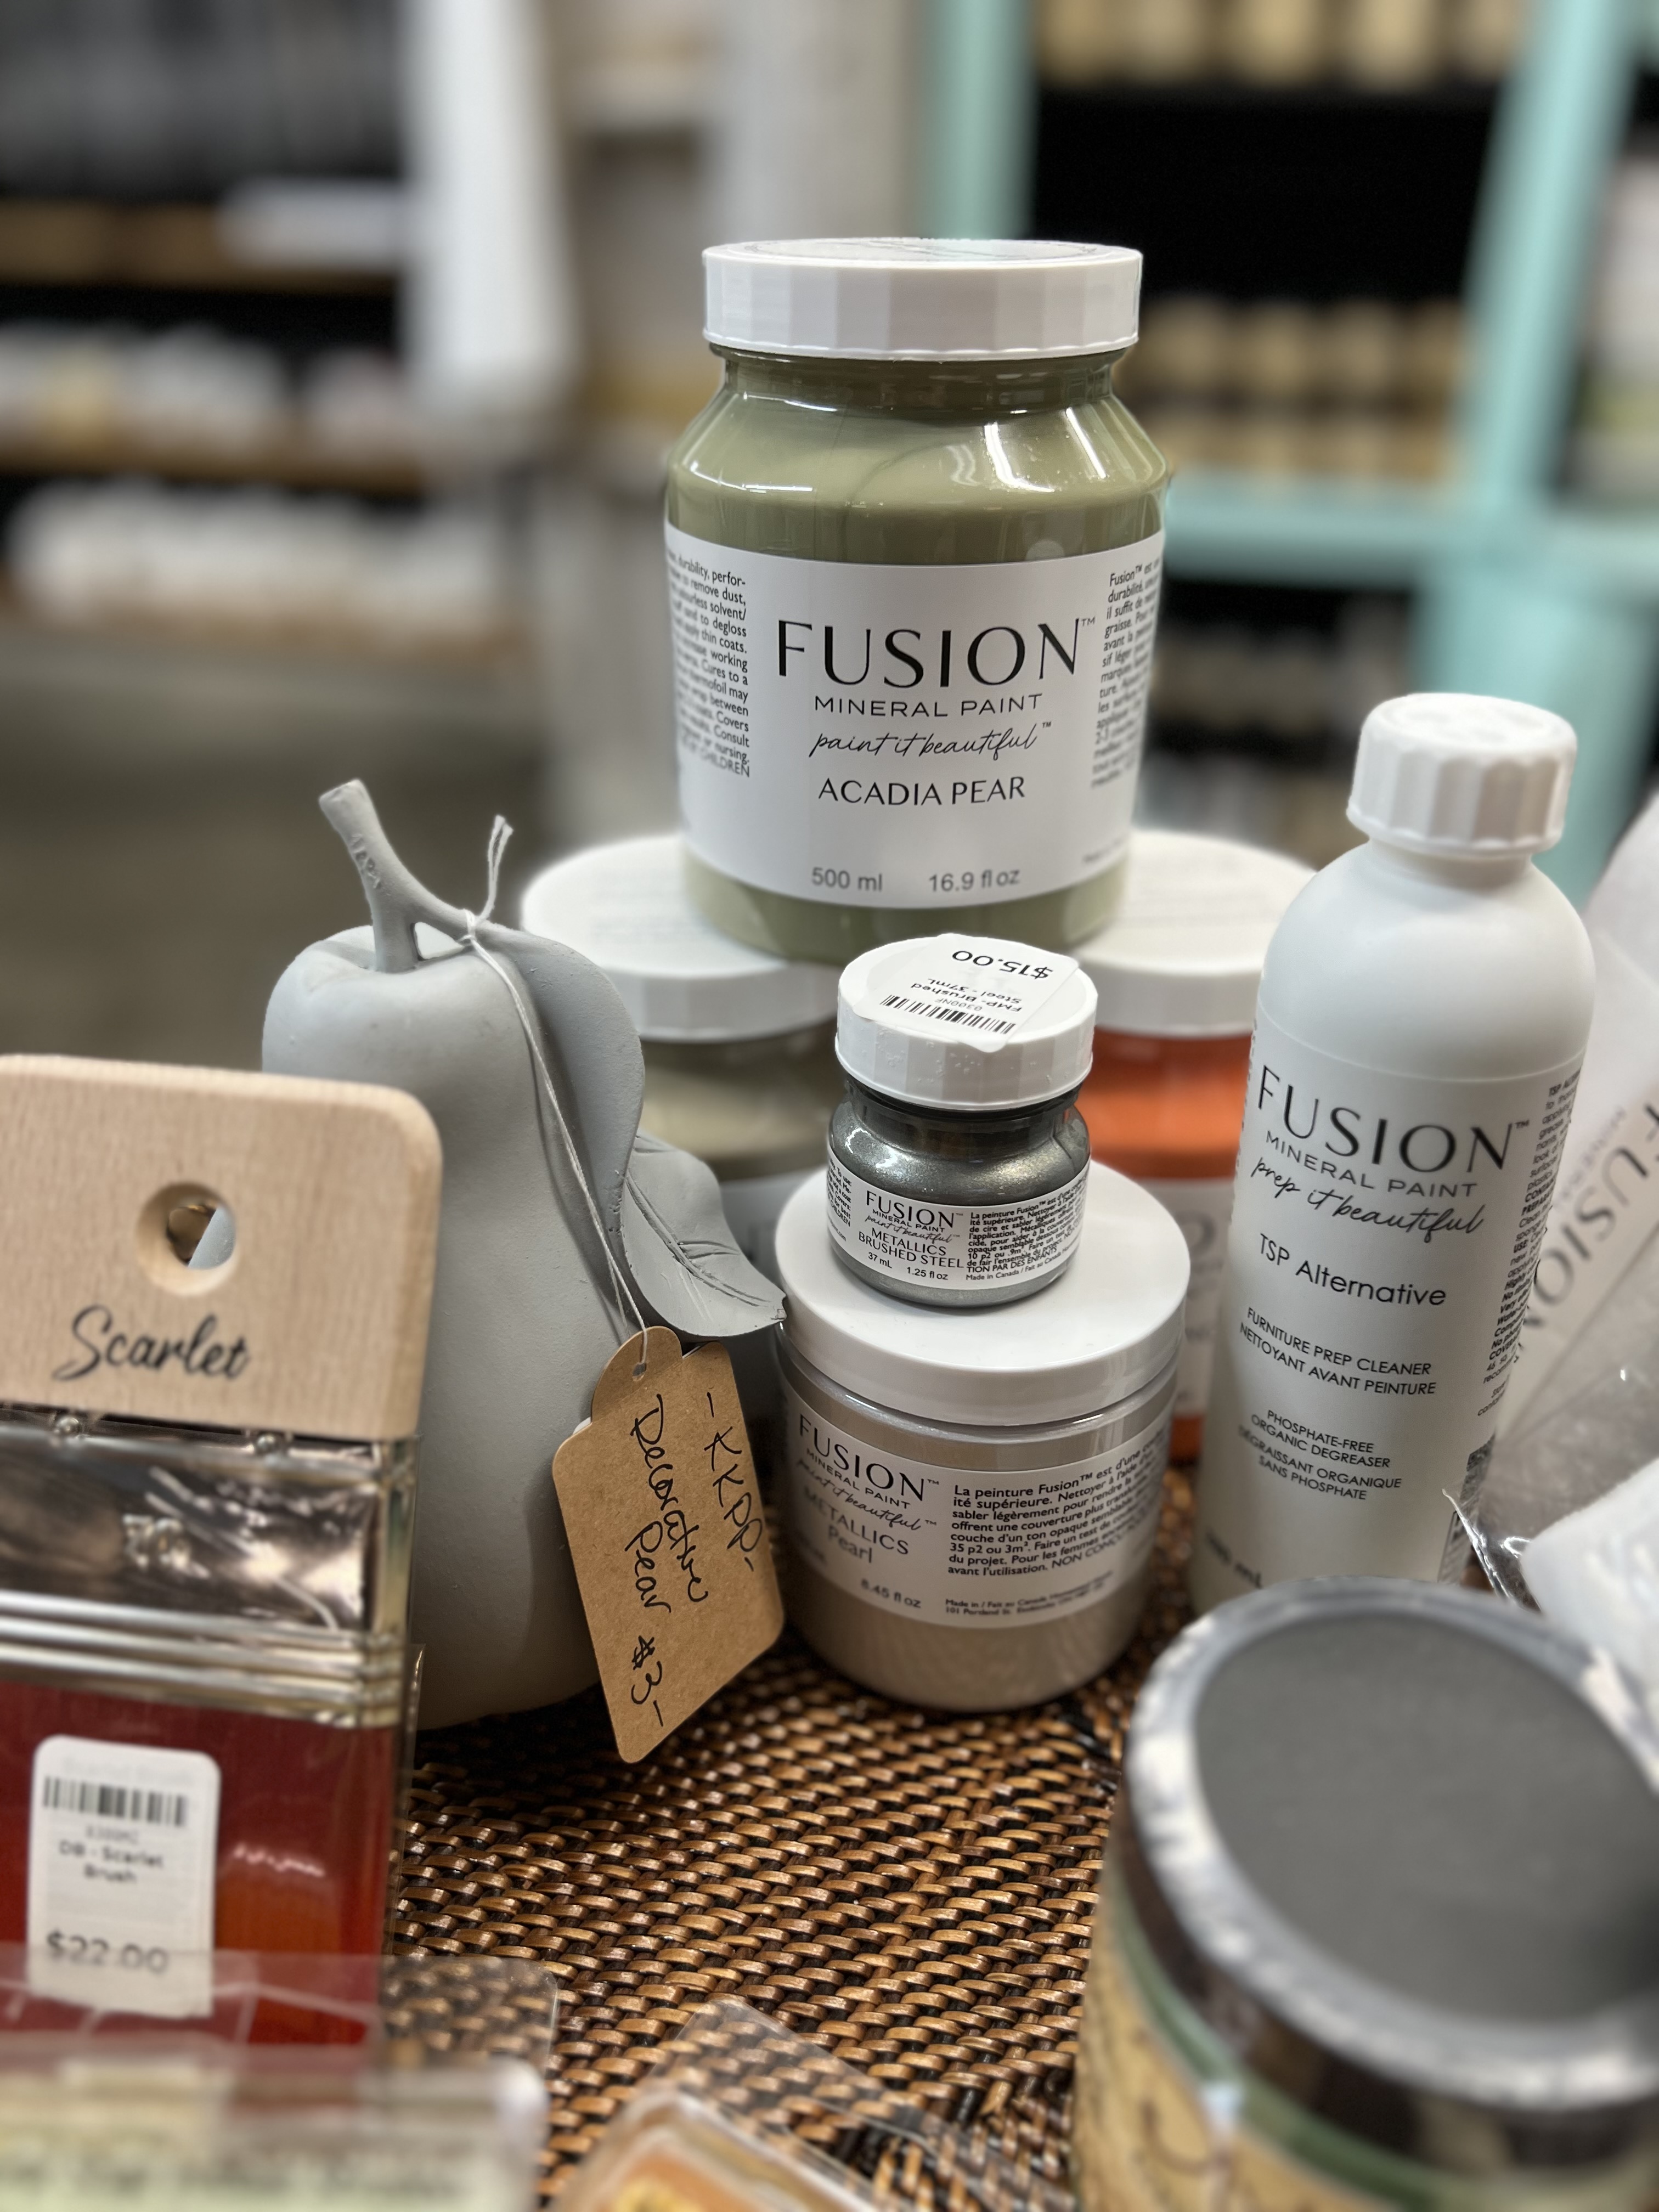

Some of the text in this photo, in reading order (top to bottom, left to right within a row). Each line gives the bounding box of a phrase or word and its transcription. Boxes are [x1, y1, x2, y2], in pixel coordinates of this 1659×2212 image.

[691, 579, 719, 597] remove
[722, 587, 746, 606] dust,
[712, 572, 746, 587] perfor-
[710, 602, 747, 620] solvent/
[701, 614, 709, 625] to
[713, 617, 747, 637] degloss
[702, 629, 716, 645] thin
[719, 637, 747, 653] coats.
[710, 652, 747, 673] working
[729, 670, 739, 682] to
[742, 675, 748, 686] a
[710, 692, 748, 716] between
[729, 687, 748, 704] may
[815, 693, 1042, 717] MINERAL PAINT
[716, 711, 749, 732] Covers
[713, 724, 750, 748] Consult
[809, 732, 898, 758] paint
[893, 735, 923, 757] it
[818, 776, 1025, 806] ACADIA PEAR
[811, 867, 1020, 892] 500 ml 16.9 fl oz
[952, 951, 1053, 979] $15.00
[911, 983, 977, 1002] Brushed
[928, 978, 1022, 1005] Steel 37mL
[1266, 1130, 1478, 1198] MINERAL PAINT
[1250, 1156, 1486, 1244] prep it beautiful
[865, 1215, 895, 1230] paint
[872, 1209, 945, 1233] MINERAL PAINT
[982, 1210, 1015, 1221] peinture
[1012, 1219, 1033, 1229] sabler
[859, 1231, 965, 1268] BRUSHED STEEL
[872, 1227, 946, 1256] METALLICS
[968, 1246, 997, 1254] opaque
[990, 1238, 1009, 1247] pour
[868, 1251, 878, 1261] 37
[879, 1257, 892, 1268] mL
[907, 1266, 927, 1277] 1.25
[966, 1265, 990, 1273] TION
[992, 1263, 1008, 1272] PAR
[1011, 1259, 1025, 1268] DES
[981, 1252, 991, 1261] p2
[1259, 1232, 1447, 1306] TSP Alternative
[52, 1304, 252, 1381] Scarlet
[1246, 1306, 1432, 1376] FURNITURE PREP CLEANER
[1239, 1322, 1437, 1396] NETTOYANT AVANT PEINTURE
[1250, 1413, 1391, 1469] ORGANIC DEGREASER
[1267, 1409, 1375, 1454] PHOSPHATE-FREE
[806, 1447, 911, 1510] MINERAL PAINT
[955, 1450, 1141, 1499] La peinture est d'une
[1258, 1454, 1368, 1501] SANS PHOSPHATE
[1316, 1466, 1403, 1489] ORGANIQUE
[952, 1510, 989, 1520] sabler
[993, 1506, 1060, 1523] légèrement
[1063, 1498, 1089, 1514] pour
[1092, 1482, 1123, 1503] rendre
[953, 1497, 971, 1508] ité
[977, 1497, 1053, 1512] supérieure.
[1058, 1480, 1106, 1503] Nettoyer
[804, 1485, 909, 1555] METALLICS
[950, 1519, 1088, 1543] couche d'un ton opaque
[951, 1521, 994, 1532] offrent
[996, 1523, 1018, 1532] une
[1021, 1512, 1082, 1531] couverture
[1084, 1504, 1104, 1519] plus
[828, 1524, 872, 1564] Pearl
[949, 1554, 963, 1564] du
[967, 1556, 1007, 1567] projet.
[1011, 1554, 1040, 1564] Pour
[1042, 1550, 1057, 1560] les
[1060, 1538, 1099, 1555] femmes
[950, 1542, 964, 1553] 35
[967, 1545, 983, 1555] p2
[1034, 1539, 1061, 1551] Faire
[1063, 1536, 1076, 1545] un
[1079, 1527, 1098, 1539] test
[625, 1521, 672, 1614] Pear
[947, 1552, 1082, 1576] avant l'utilisation. NON
[904, 1598, 922, 1609] oz
[945, 1599, 968, 1608] Made
[46, 1928, 169, 1976] $22.00
